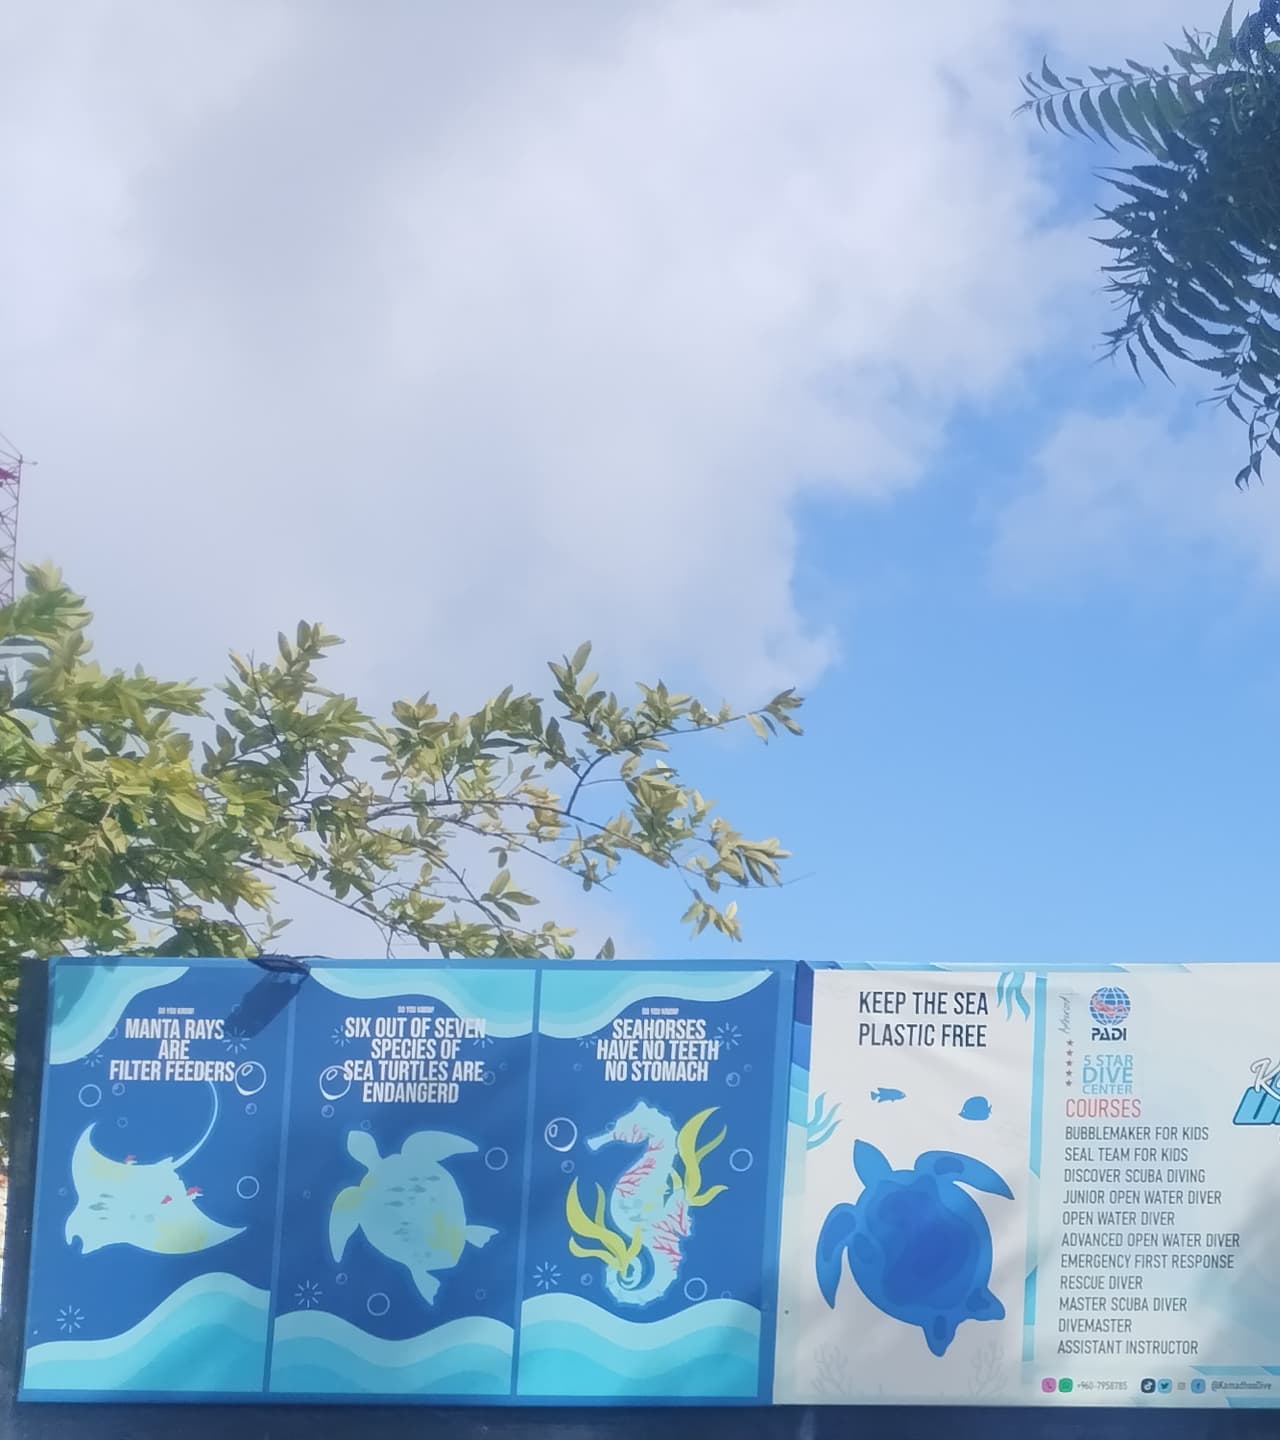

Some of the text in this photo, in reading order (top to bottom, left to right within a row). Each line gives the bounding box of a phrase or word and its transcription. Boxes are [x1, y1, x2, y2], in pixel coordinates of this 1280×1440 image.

[859, 991, 989, 1015] KEEP THE SEA
[125, 1018, 224, 1039] MANTA RAYS
[345, 1017, 486, 1038] SIX OUT OF SEVEN
[613, 1019, 706, 1039] SEAHORSES
[858, 1023, 987, 1047] PLASTIC FREE
[1091, 1027, 1127, 1041] PADI
[158, 1040, 190, 1059] ARE
[371, 1039, 462, 1059] SPECIES OF
[597, 1039, 719, 1060] HAVE NO TEETH
[1083, 1054, 1133, 1067] 5 STAR
[110, 1060, 235, 1081] FILTER FEEDERS
[343, 1060, 485, 1081] SEA TURTLES ARE
[605, 1061, 708, 1081] NO STOMACH
[1082, 1067, 1133, 1084] DIVE
[363, 1082, 459, 1103] ENDANGERD
[1082, 1084, 1133, 1095] CENTER
[1066, 1099, 1141, 1118] COURSES
[1065, 1126, 1209, 1140] BUBBLEMAKER FOR KIDS
[1065, 1148, 1188, 1161] SEAL TEAM FOR KIDS
[1064, 1169, 1206, 1183] DISCOVER SCUBA DIVING
[1063, 1190, 1222, 1204] JUNIOR OPEN WATER DIVER
[1063, 1211, 1175, 1225] OPEN WATER DIVER
[1061, 1232, 1240, 1247] ADVANCED OPEN WATER DIVER
[1061, 1254, 1235, 1268] EMERGENCY FIRST RESPONSE
[1060, 1275, 1143, 1290] RESCUE DIVER
[1059, 1297, 1187, 1312] MASTER SCUBA DIVER
[1058, 1318, 1132, 1333] DIVEMASTER
[1057, 1340, 1198, 1355] ASSISTANT INSTRUCTOR
